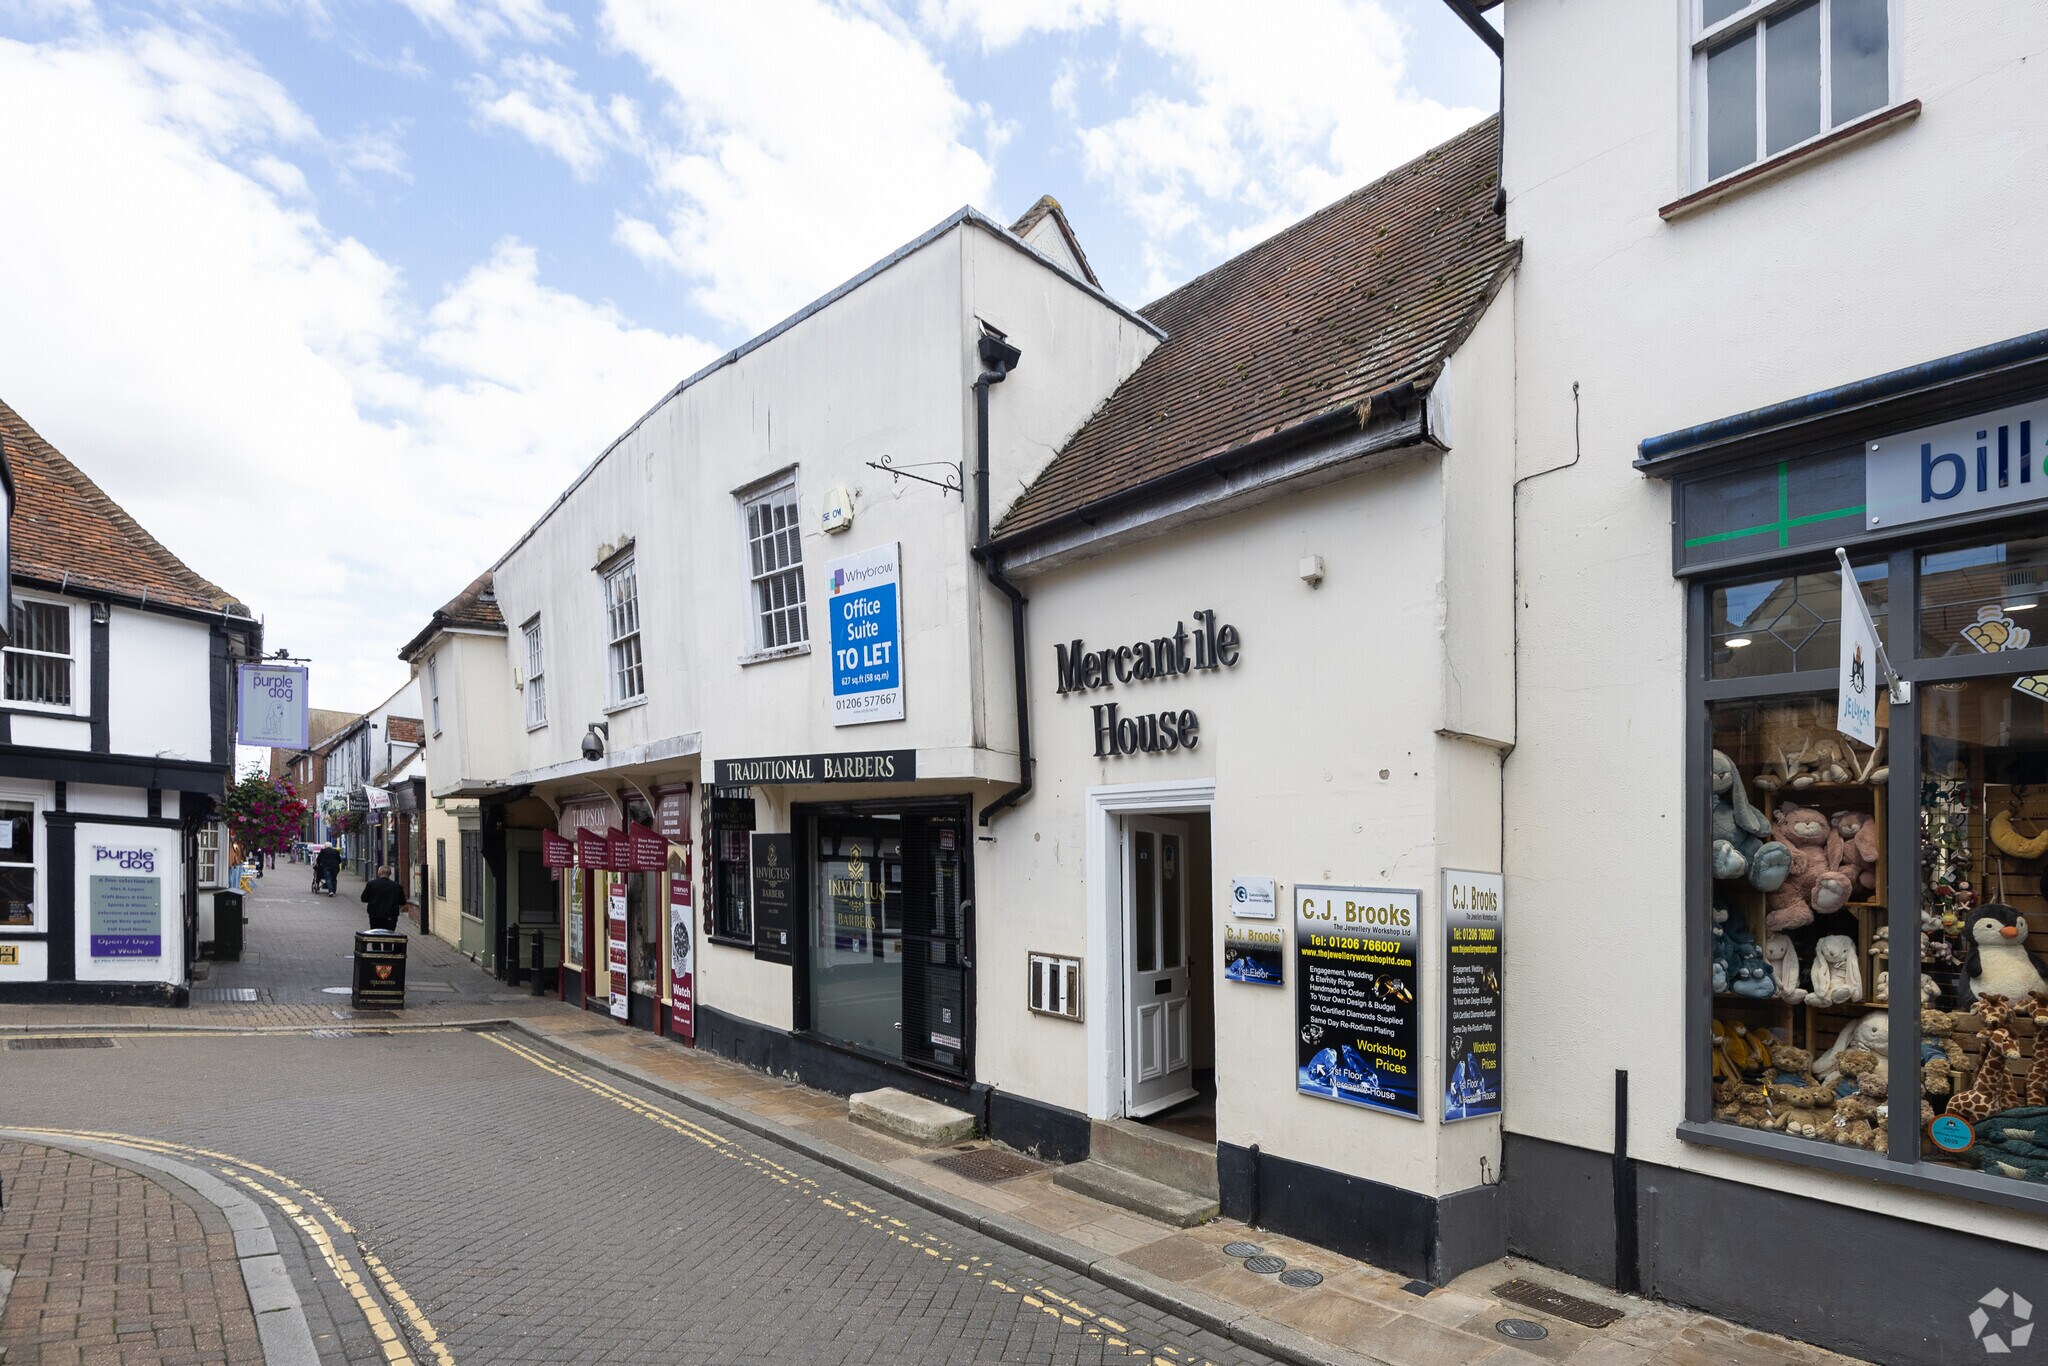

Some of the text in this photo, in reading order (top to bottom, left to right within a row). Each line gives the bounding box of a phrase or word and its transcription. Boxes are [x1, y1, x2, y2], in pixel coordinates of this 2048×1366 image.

[1921, 420, 2048, 504] bill
[845, 562, 893, 582] Whybrow
[844, 598, 880, 620] Office
[848, 620, 878, 640] Suite
[837, 641, 892, 671] TO LET
[1054, 609, 1240, 694] Mercantile
[253, 675, 292, 689] purple
[842, 671, 889, 685] 627 sq.ft (58 sq.m)
[269, 685, 292, 702] dog
[836, 693, 896, 710] 01206 577667
[1090, 702, 1199, 756] House
[727, 756, 894, 781] TRADITIONAL BARBERS
[572, 808, 605, 826] TIMPSON
[96, 849, 154, 861] purple
[120, 859, 154, 872] dog
[756, 867, 790, 880] INVICTUS
[762, 889, 785, 899] BARBERS
[828, 879, 886, 900] INVICTUS
[1452, 885, 1497, 911] C.J. Brooks
[838, 913, 876, 929] BARBERS
[1303, 899, 1410, 927] C.J. Brooks
[1227, 928, 1280, 943] C.J. Brooks
[1344, 925, 1371, 934] Jewellery
[1372, 927, 1400, 936] Workshop
[1454, 928, 1495, 940] Tel: 01206 766007
[1310, 934, 1400, 953] Tel: 01206 766007
[1301, 949, 1411, 966] www.thejewelleryworkshopltd.com
[1310, 966, 1373, 981] Engagement, Wedding
[1316, 976, 1336, 986] Eternity
[1338, 979, 1354, 988] Rings
[673, 983, 690, 998] Watch
[1310, 984, 1340, 994] Handmade
[1348, 989, 1365, 997] Order
[674, 999, 690, 1011] Repairs
[1347, 999, 1367, 1008] Design
[1374, 1002, 1396, 1012] Budget
[1322, 1006, 1345, 1016] Certified
[1347, 1010, 1375, 1020] Diamonds
[1377, 1014, 1403, 1025] Supplied
[1310, 1016, 1394, 1037] Same Day Re-Rodium Plating
[1357, 1039, 1406, 1060] Workshop
[1473, 1041, 1496, 1054] Workshop
[1376, 1058, 1407, 1074] Prices
[1482, 1058, 1496, 1069] Prices
[1344, 1069, 1362, 1080] Floor
[1330, 1078, 1396, 1100] Mercantile House
[1467, 1079, 1478, 1088] Floor
[1482, 1091, 1496, 1100] House
